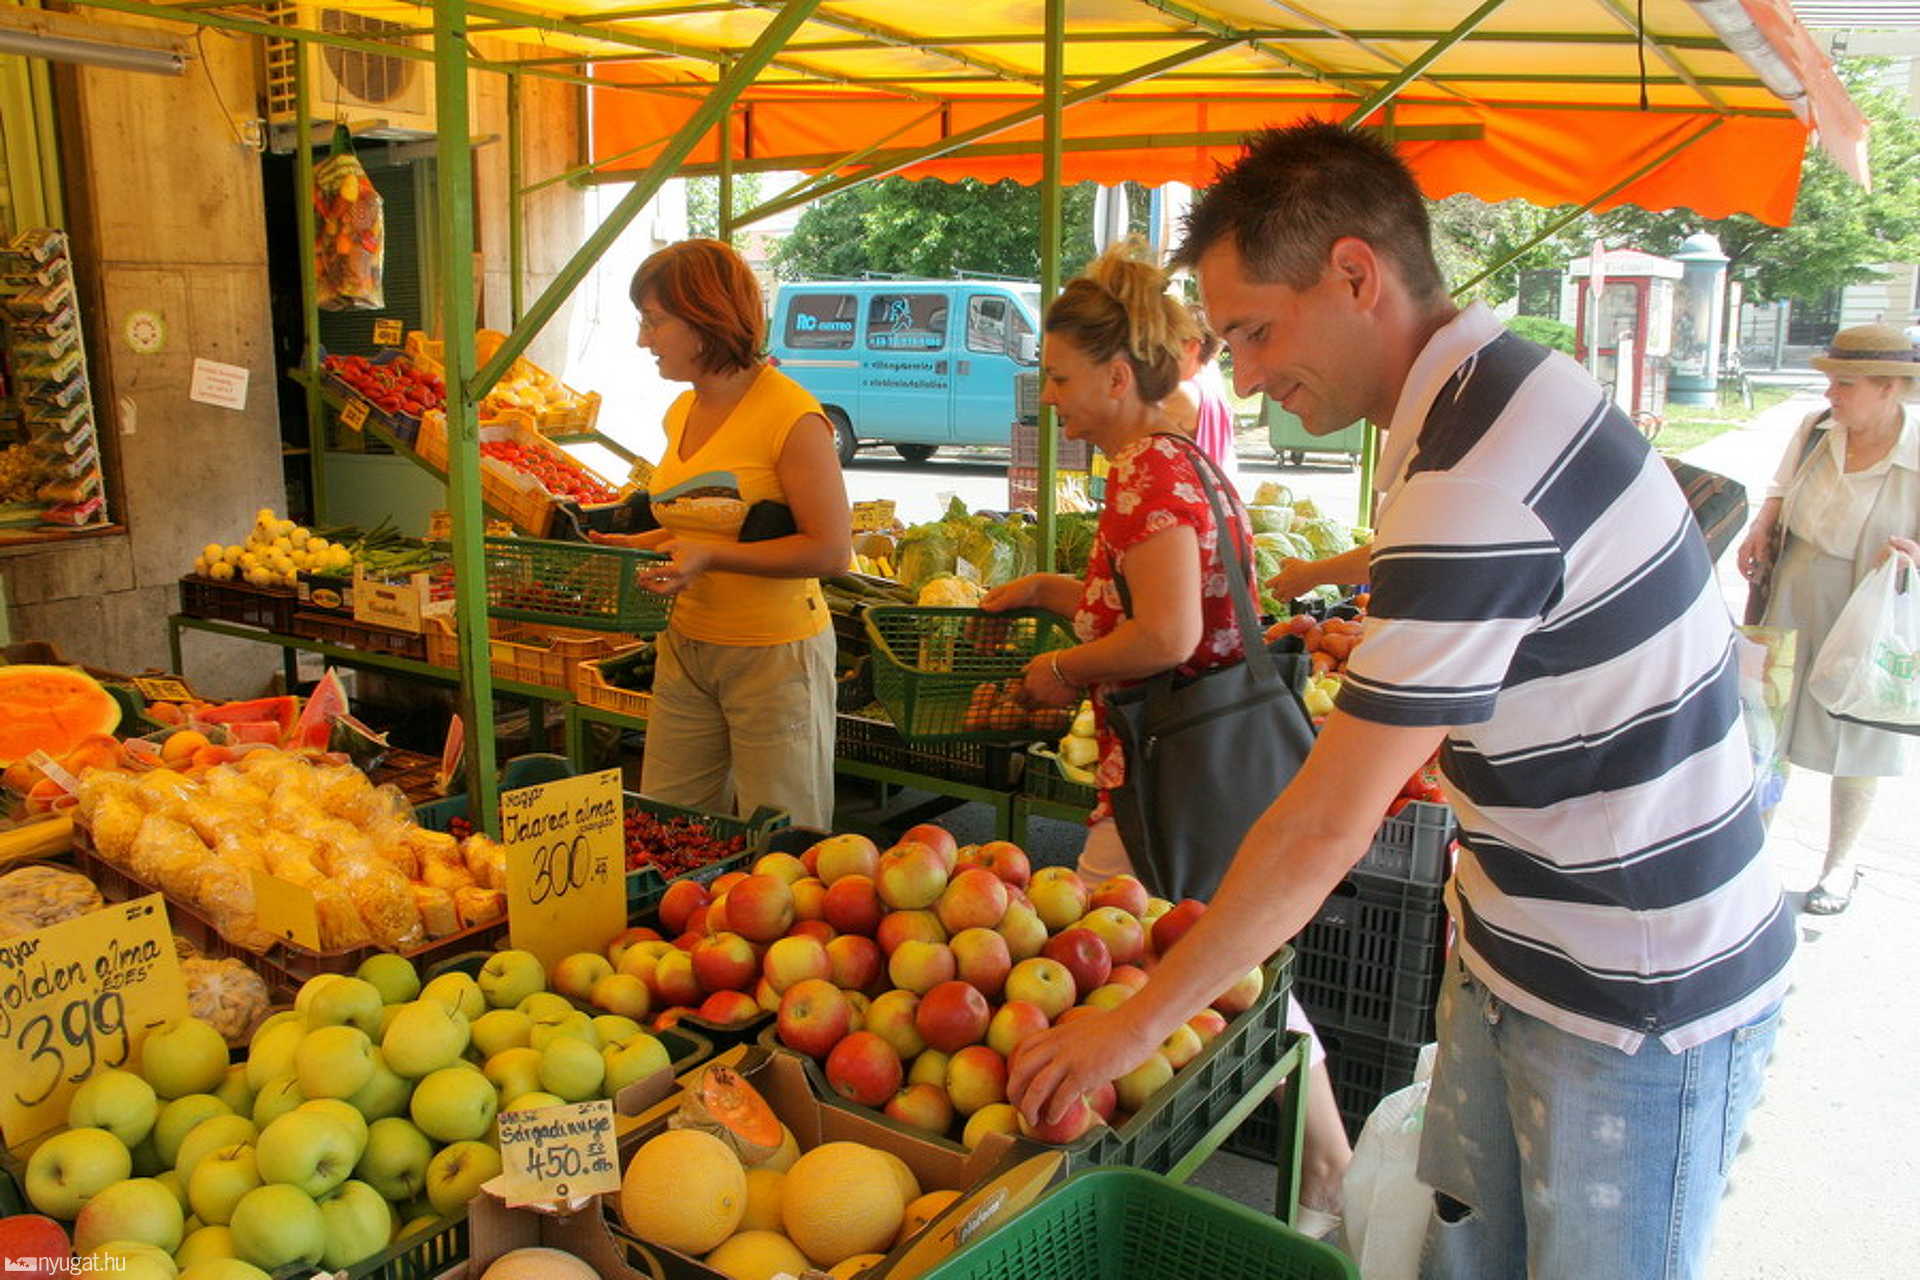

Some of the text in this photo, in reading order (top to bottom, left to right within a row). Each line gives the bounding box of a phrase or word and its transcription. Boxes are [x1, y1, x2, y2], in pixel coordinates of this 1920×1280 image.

[575, 796, 616, 823] alma
[95, 938, 162, 979] alma
[15, 992, 130, 1107] 399
